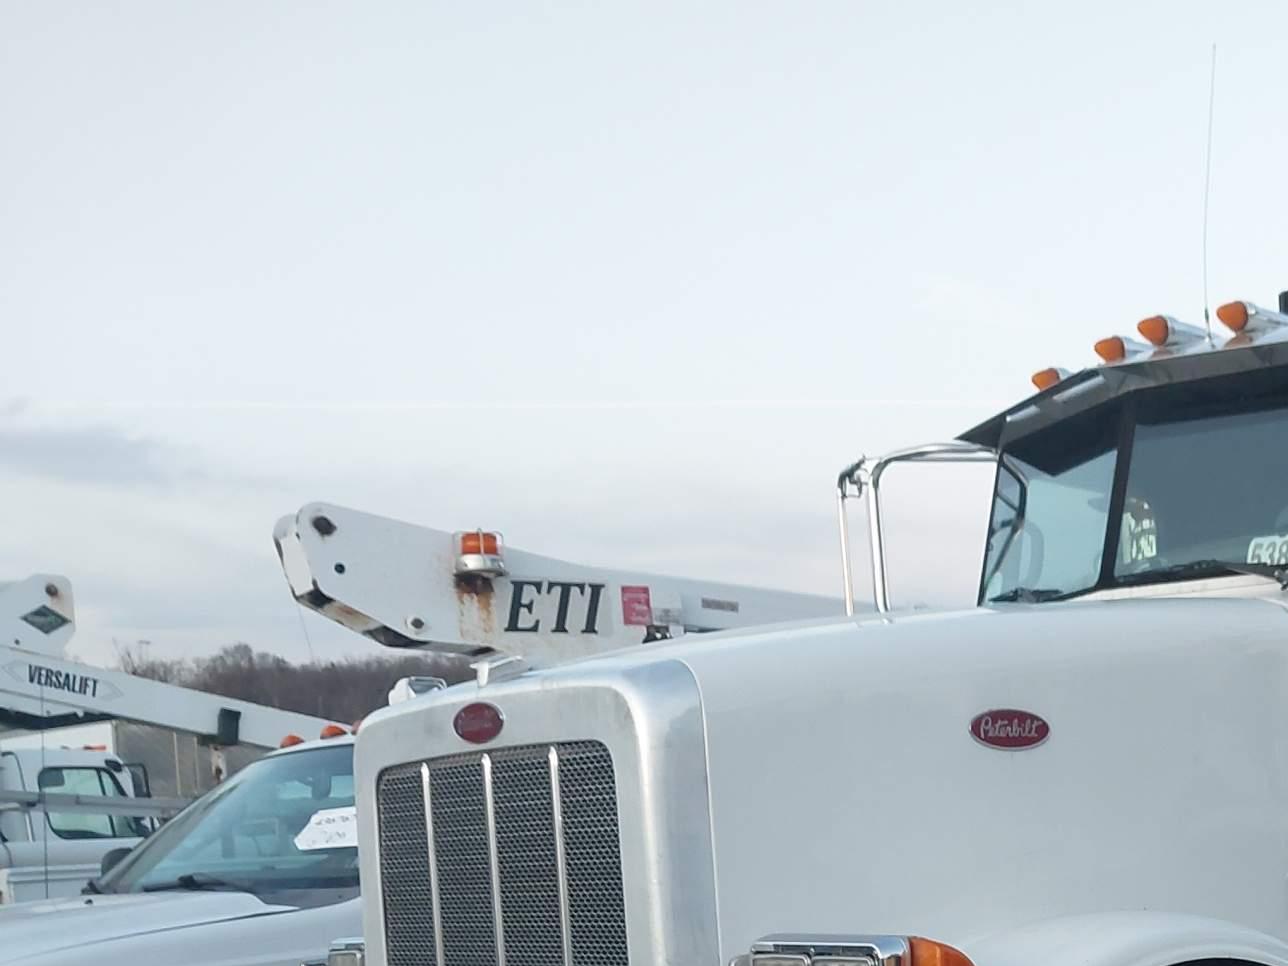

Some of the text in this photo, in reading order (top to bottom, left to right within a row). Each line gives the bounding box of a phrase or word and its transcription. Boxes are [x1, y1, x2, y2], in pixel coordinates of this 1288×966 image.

[504, 580, 605, 634] ETI
[28, 663, 99, 698] VERSALIFT
[980, 715, 1044, 739] Peterbilt
